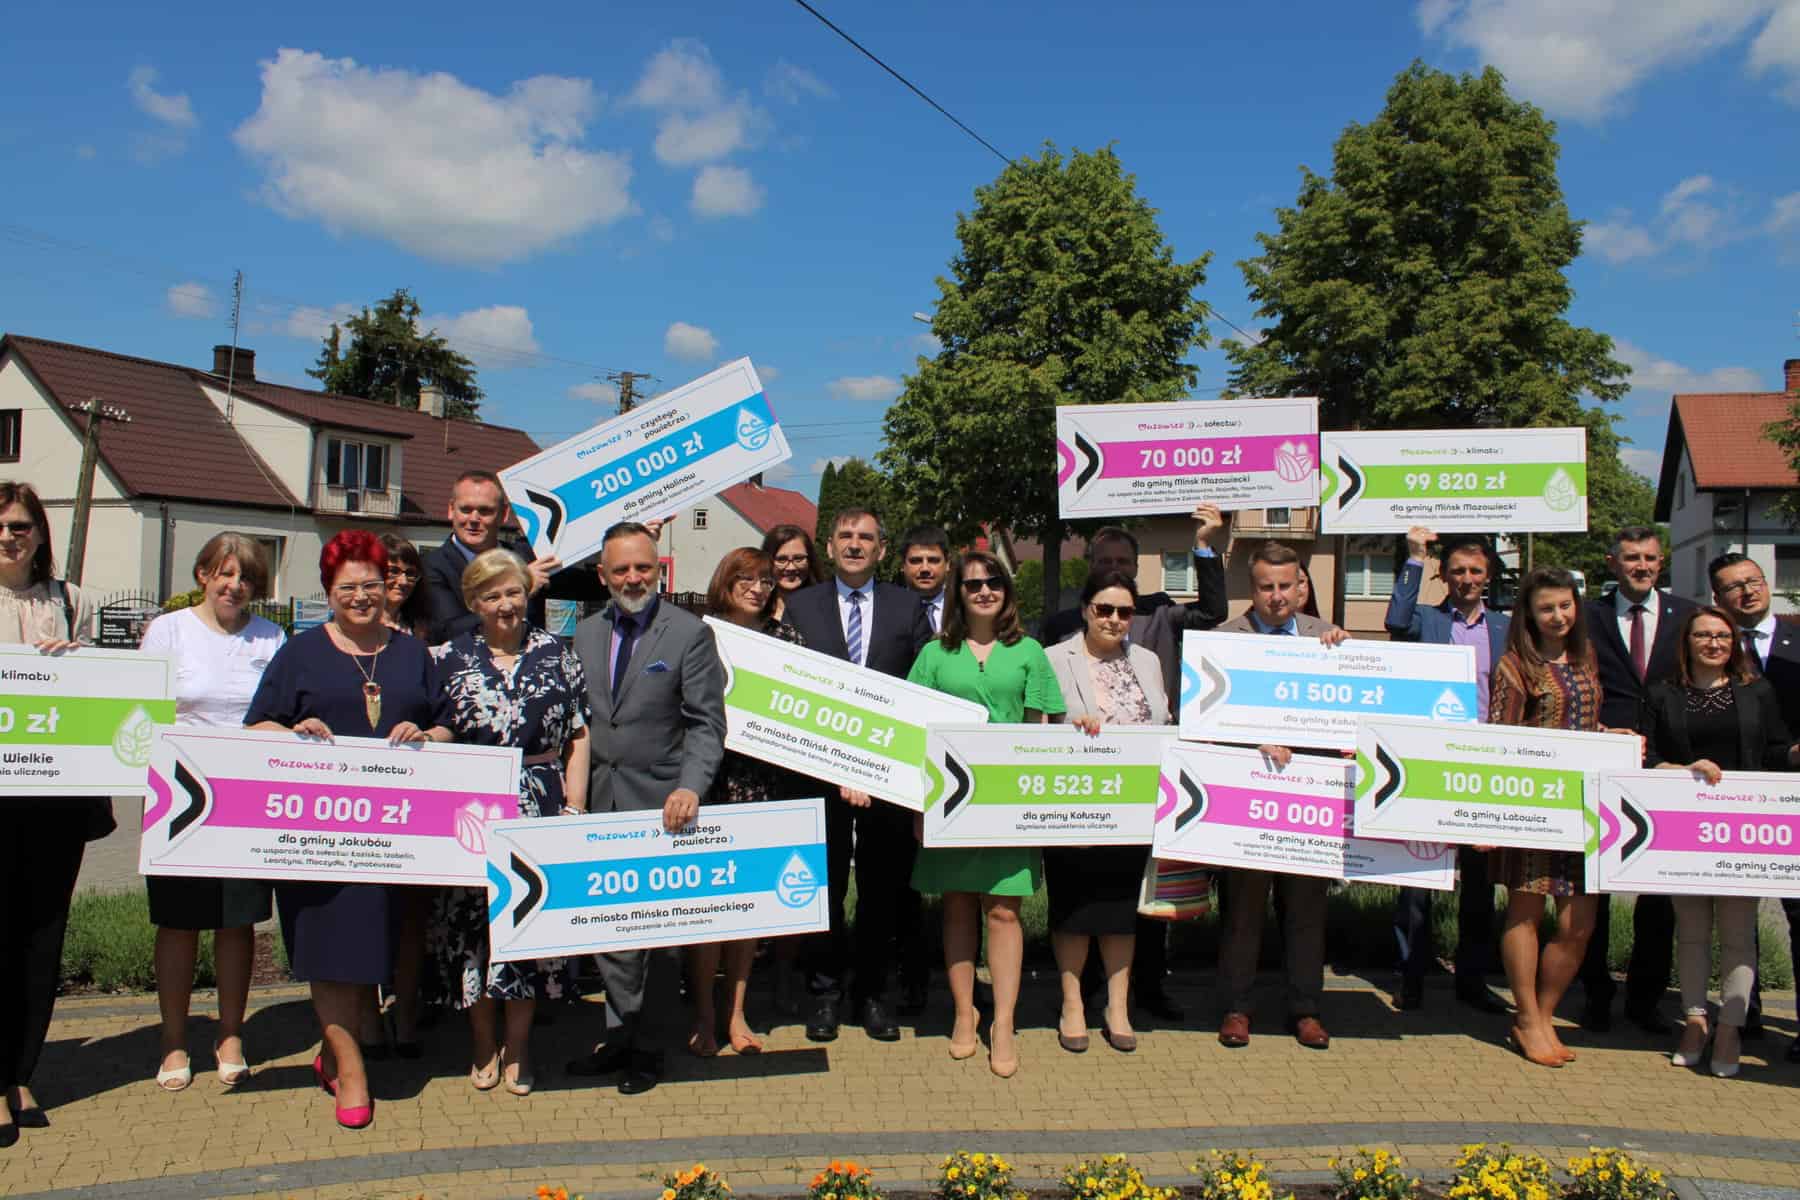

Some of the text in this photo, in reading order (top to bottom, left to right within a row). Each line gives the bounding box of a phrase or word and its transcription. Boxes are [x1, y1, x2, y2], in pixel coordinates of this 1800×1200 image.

[640, 408, 678, 430] czystego
[644, 414, 686, 440] powietrza
[1203, 419, 1237, 428] sołectw
[1139, 443, 1243, 469] 70 000 zł
[1466, 447, 1499, 455] klimatu
[590, 431, 705, 500] 200 000 zł
[1131, 480, 1146, 488] dla
[1146, 479, 1173, 490] gminy
[1200, 474, 1250, 485] Mazowiecki
[1404, 470, 1507, 491] 99 820 zł
[623, 472, 697, 512] dla gminy Halinów
[1390, 504, 1405, 512] dla
[1405, 504, 1433, 513] gminy
[1463, 503, 1517, 511] Mazowiecki
[1338, 652, 1382, 663] czystego
[1, 669, 51, 682] klimatu
[1338, 662, 1387, 672] powietrza
[853, 685, 891, 704] klimatu
[1274, 681, 1385, 705] 61 500 zł
[26, 706, 60, 735] zł
[767, 689, 896, 748] 100 000 zł
[1282, 714, 1298, 722] dla
[1299, 715, 1329, 727] gminy
[745, 720, 891, 774] dla miasta Mińsk Mazowiecki
[1083, 743, 1117, 754] klimatu
[1516, 747, 1552, 758] klimatu
[3, 752, 54, 765] Wielkie
[267, 757, 409, 776] Mazowsze sołectw
[13, 767, 61, 778] ulicznego
[1017, 772, 1124, 796] 98 523 zł
[1442, 770, 1566, 800] 100 000 zł
[264, 793, 412, 825] 50 000 zł
[1022, 810, 1112, 823] dla gminy Kałuszyn
[1248, 799, 1279, 821] 50
[1286, 803, 1334, 828] 000
[1453, 808, 1549, 824] dla gminy Latowicz
[586, 830, 647, 842] Mazowsze
[681, 824, 721, 836] zystego
[1697, 821, 1793, 847] 30 000
[278, 833, 392, 849] dla gminy Jakubów
[672, 836, 728, 849] powietrza
[1259, 832, 1351, 851] dla gminy Kałuszyn
[262, 847, 300, 857] wsparcie
[301, 848, 314, 856] dla
[1715, 860, 1733, 870] dla
[1734, 861, 1767, 872] gminy
[586, 859, 737, 897] 200 000 zł
[570, 901, 755, 926] dla miasta Mińska Mazowieckiego
